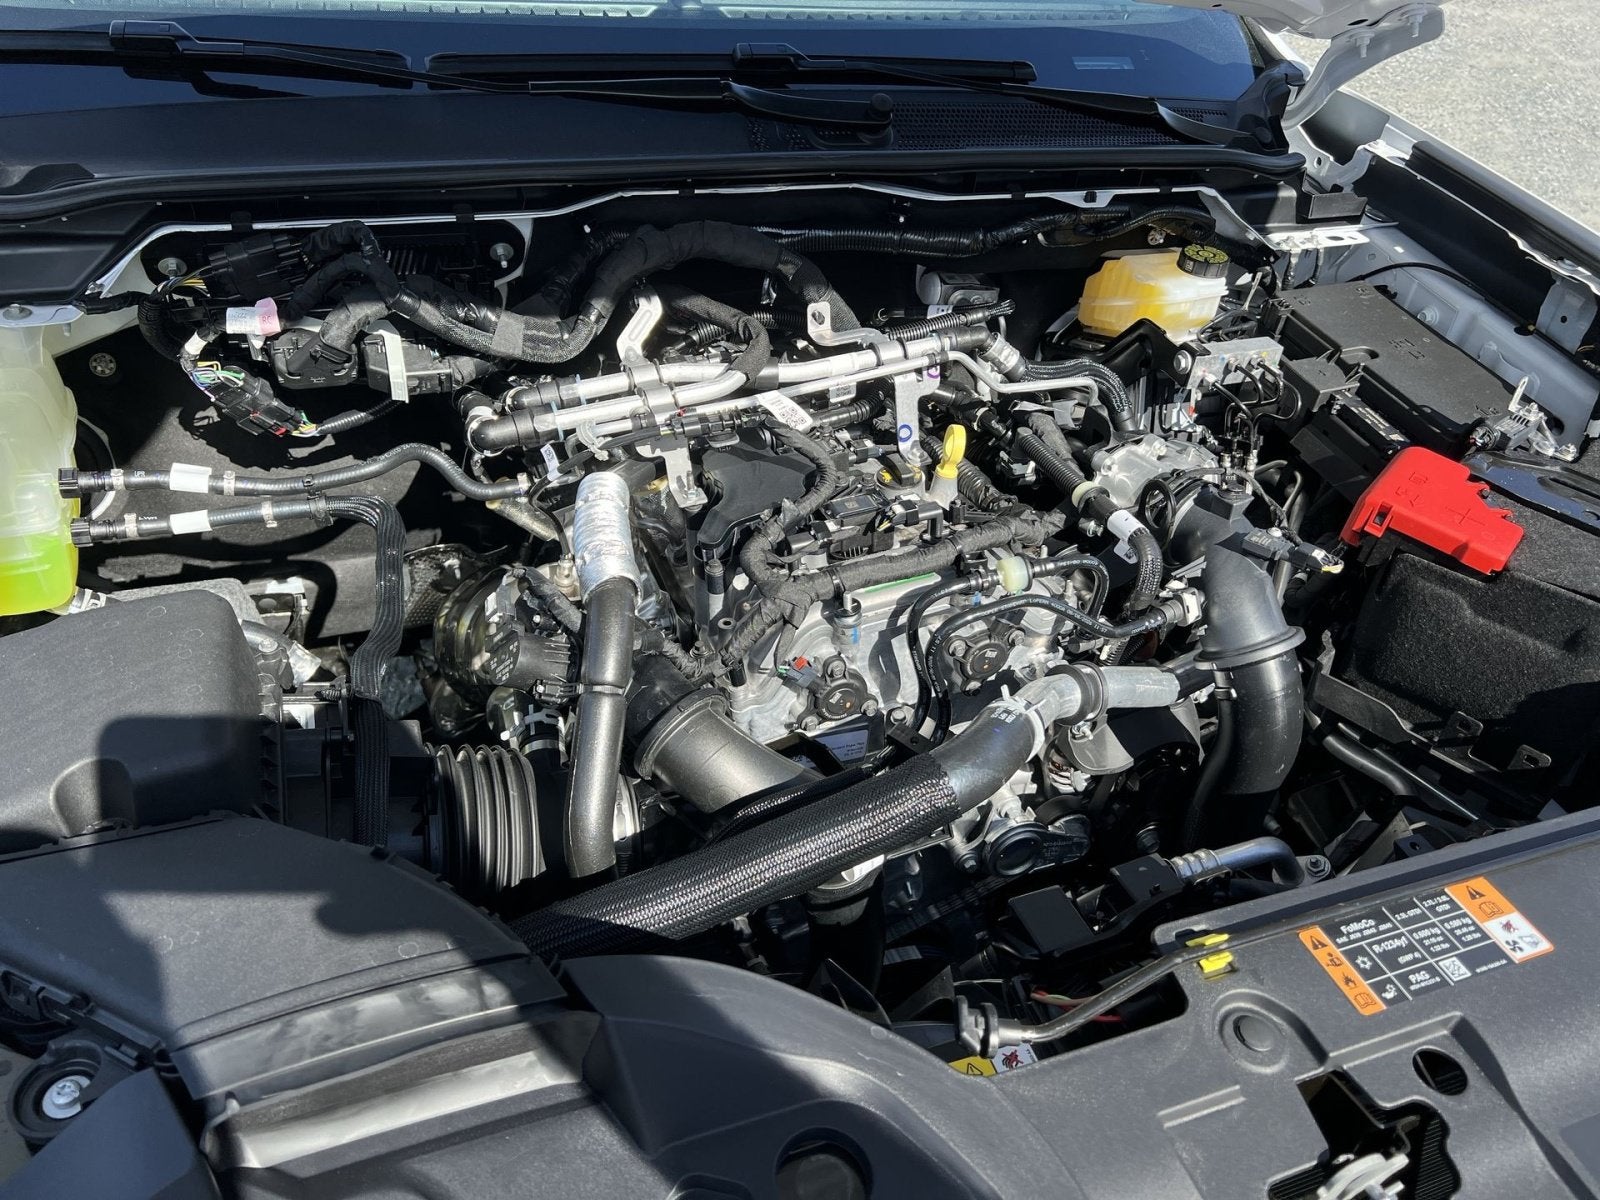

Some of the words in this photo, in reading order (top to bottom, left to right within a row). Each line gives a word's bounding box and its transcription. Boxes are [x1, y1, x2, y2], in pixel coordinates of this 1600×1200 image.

[1340, 919, 1376, 934] FoMoCo
[1372, 936, 1408, 954] R-1234yf
[1408, 970, 1430, 984] PAG
